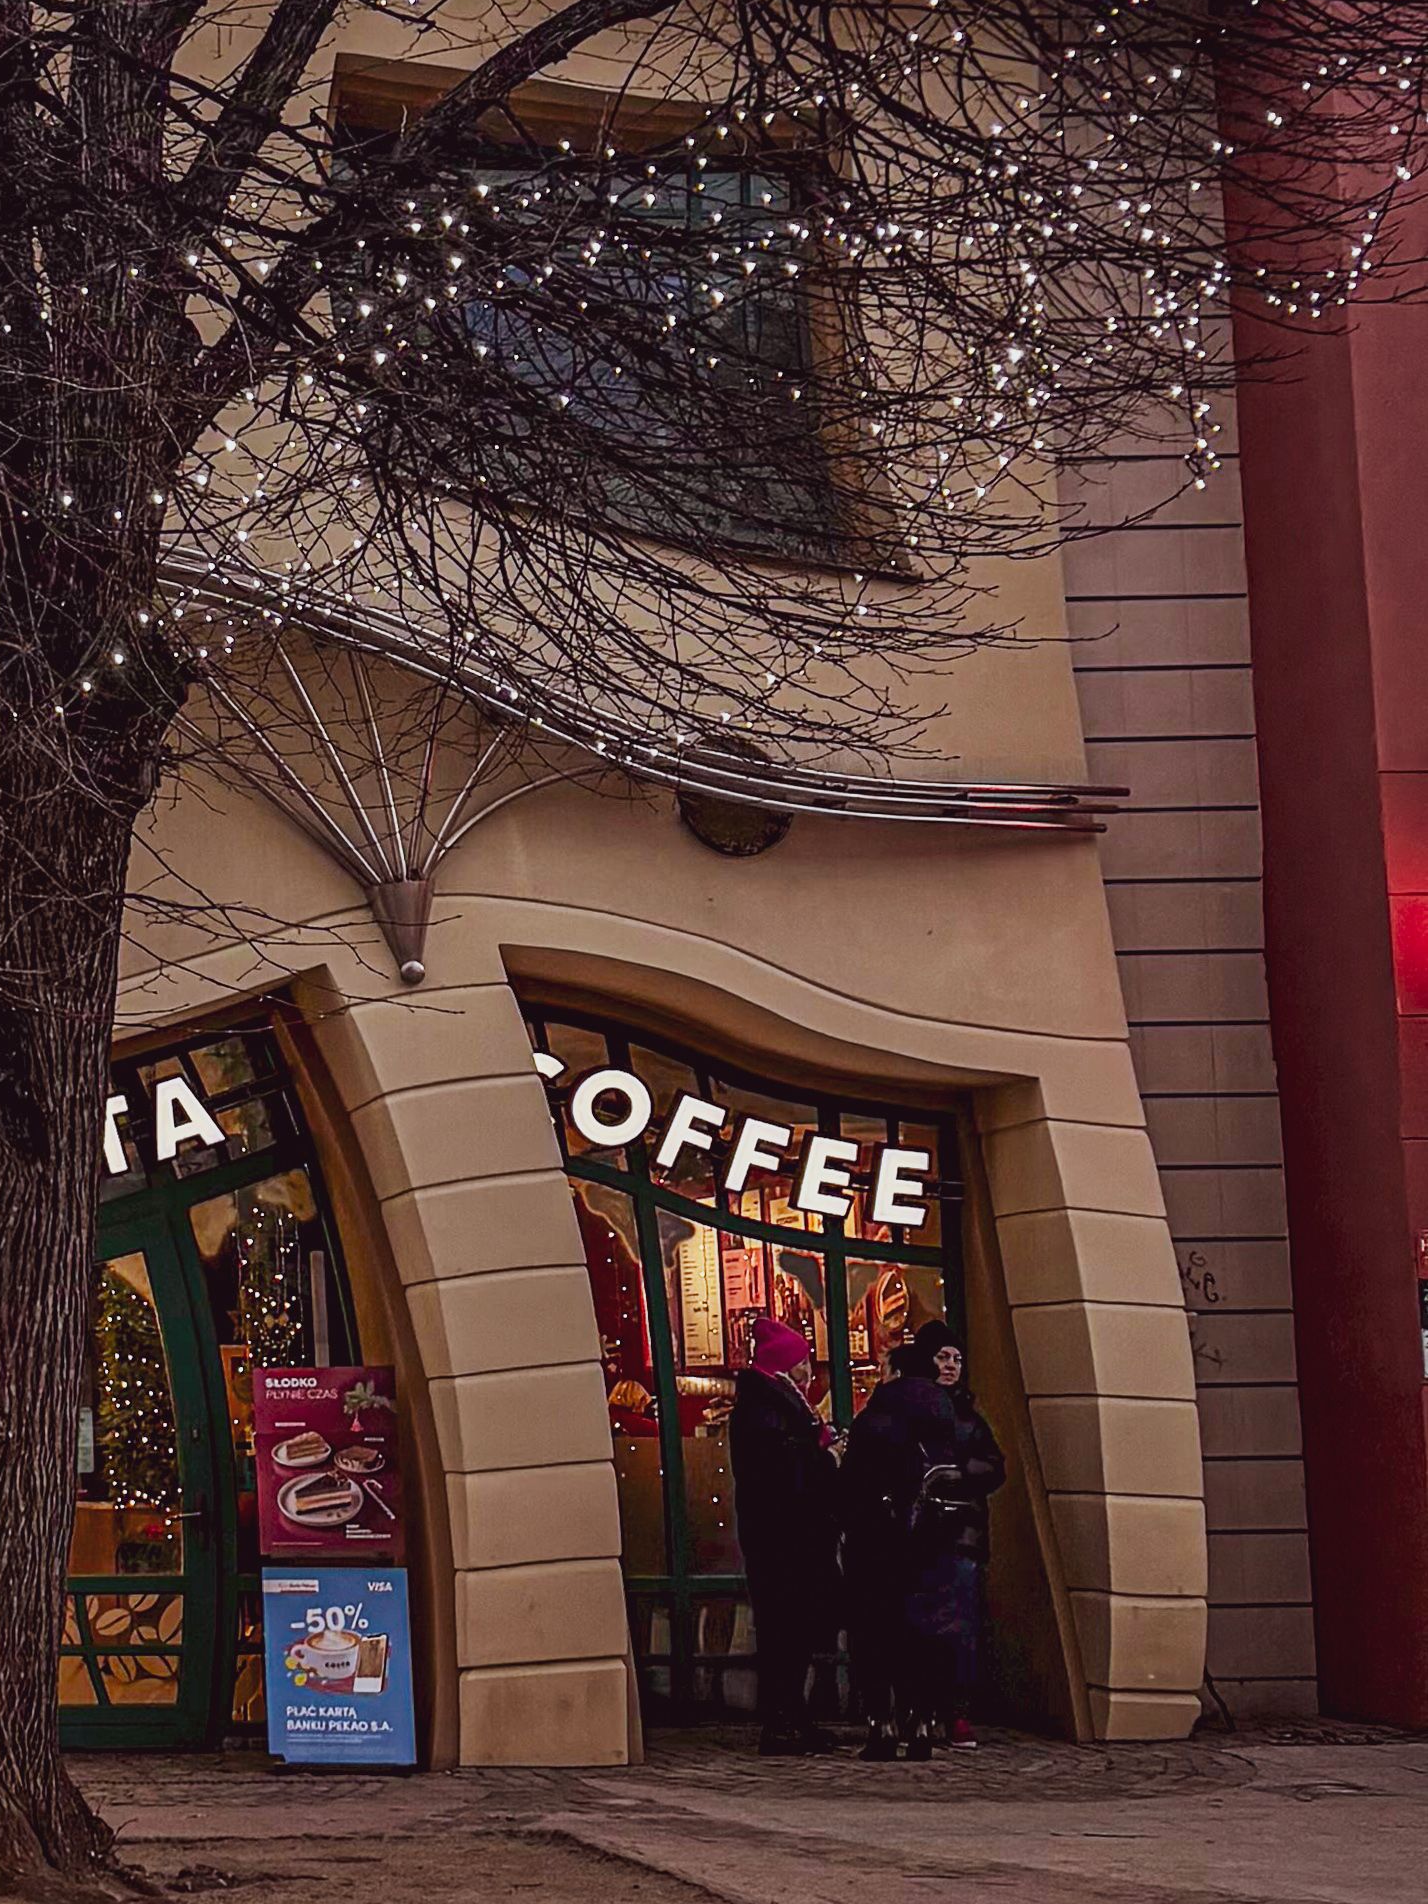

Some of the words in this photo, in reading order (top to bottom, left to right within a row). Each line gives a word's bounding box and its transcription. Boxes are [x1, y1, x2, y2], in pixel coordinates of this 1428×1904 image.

[532, 1051, 931, 1227] OFFEE
[306, 1388, 339, 1400] CZAS
[367, 1581, 394, 1592] VISA
[290, 1602, 369, 1633] -50%
[286, 1719, 326, 1732] BANKU
[327, 1720, 369, 1732] PEKAO
